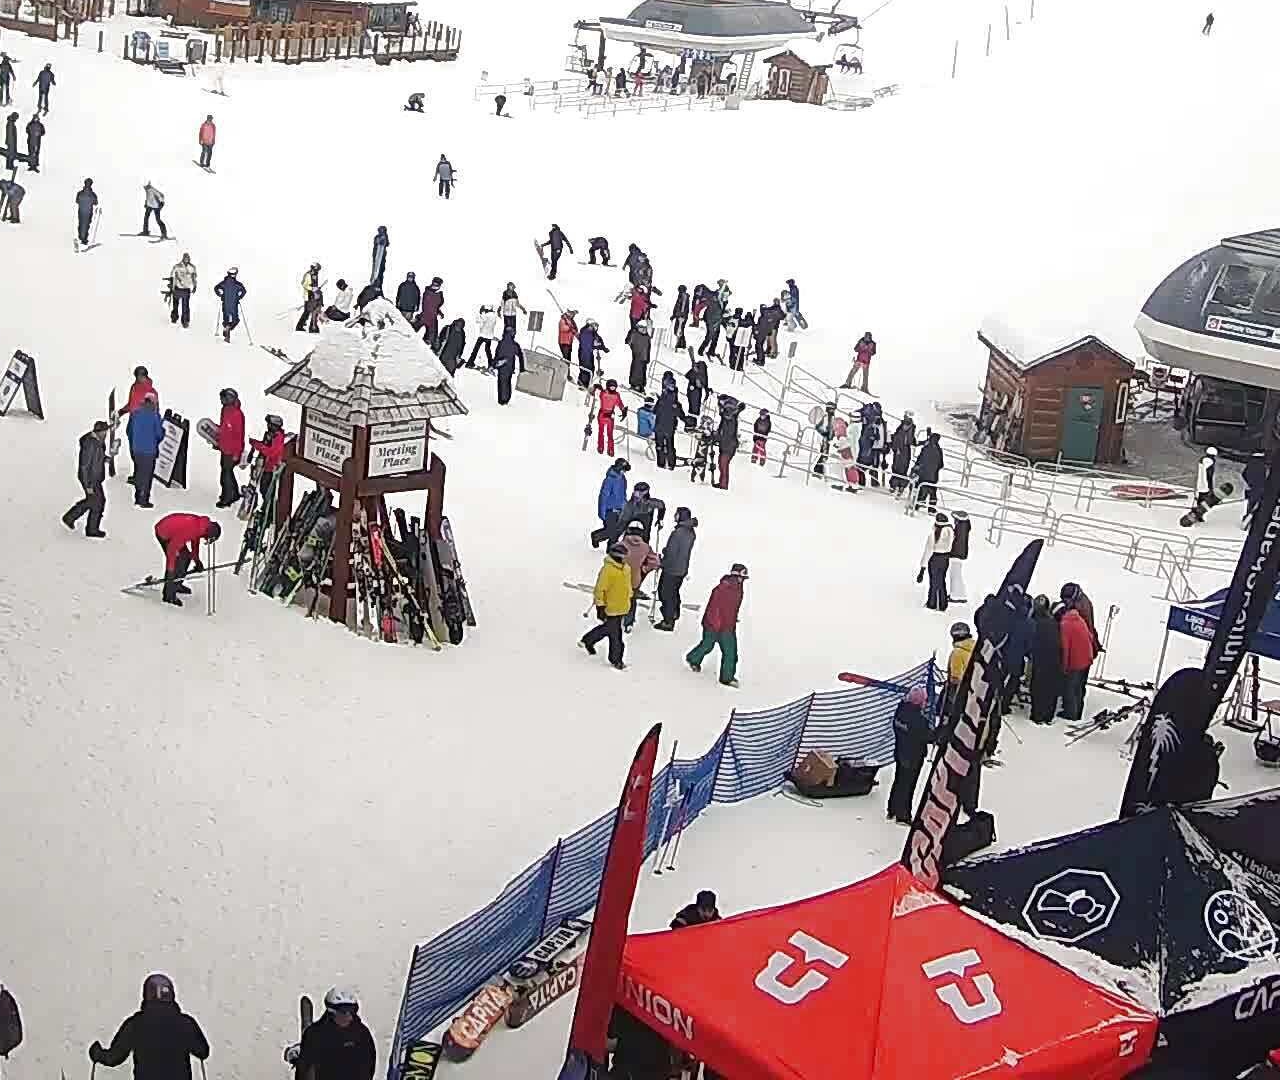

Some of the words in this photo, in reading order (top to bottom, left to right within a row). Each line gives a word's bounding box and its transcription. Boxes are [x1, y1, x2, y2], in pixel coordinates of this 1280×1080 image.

[315, 444, 341, 463] Place
[377, 443, 418, 458] Meeting
[383, 456, 412, 469] Place
[623, 975, 694, 1041] NION
